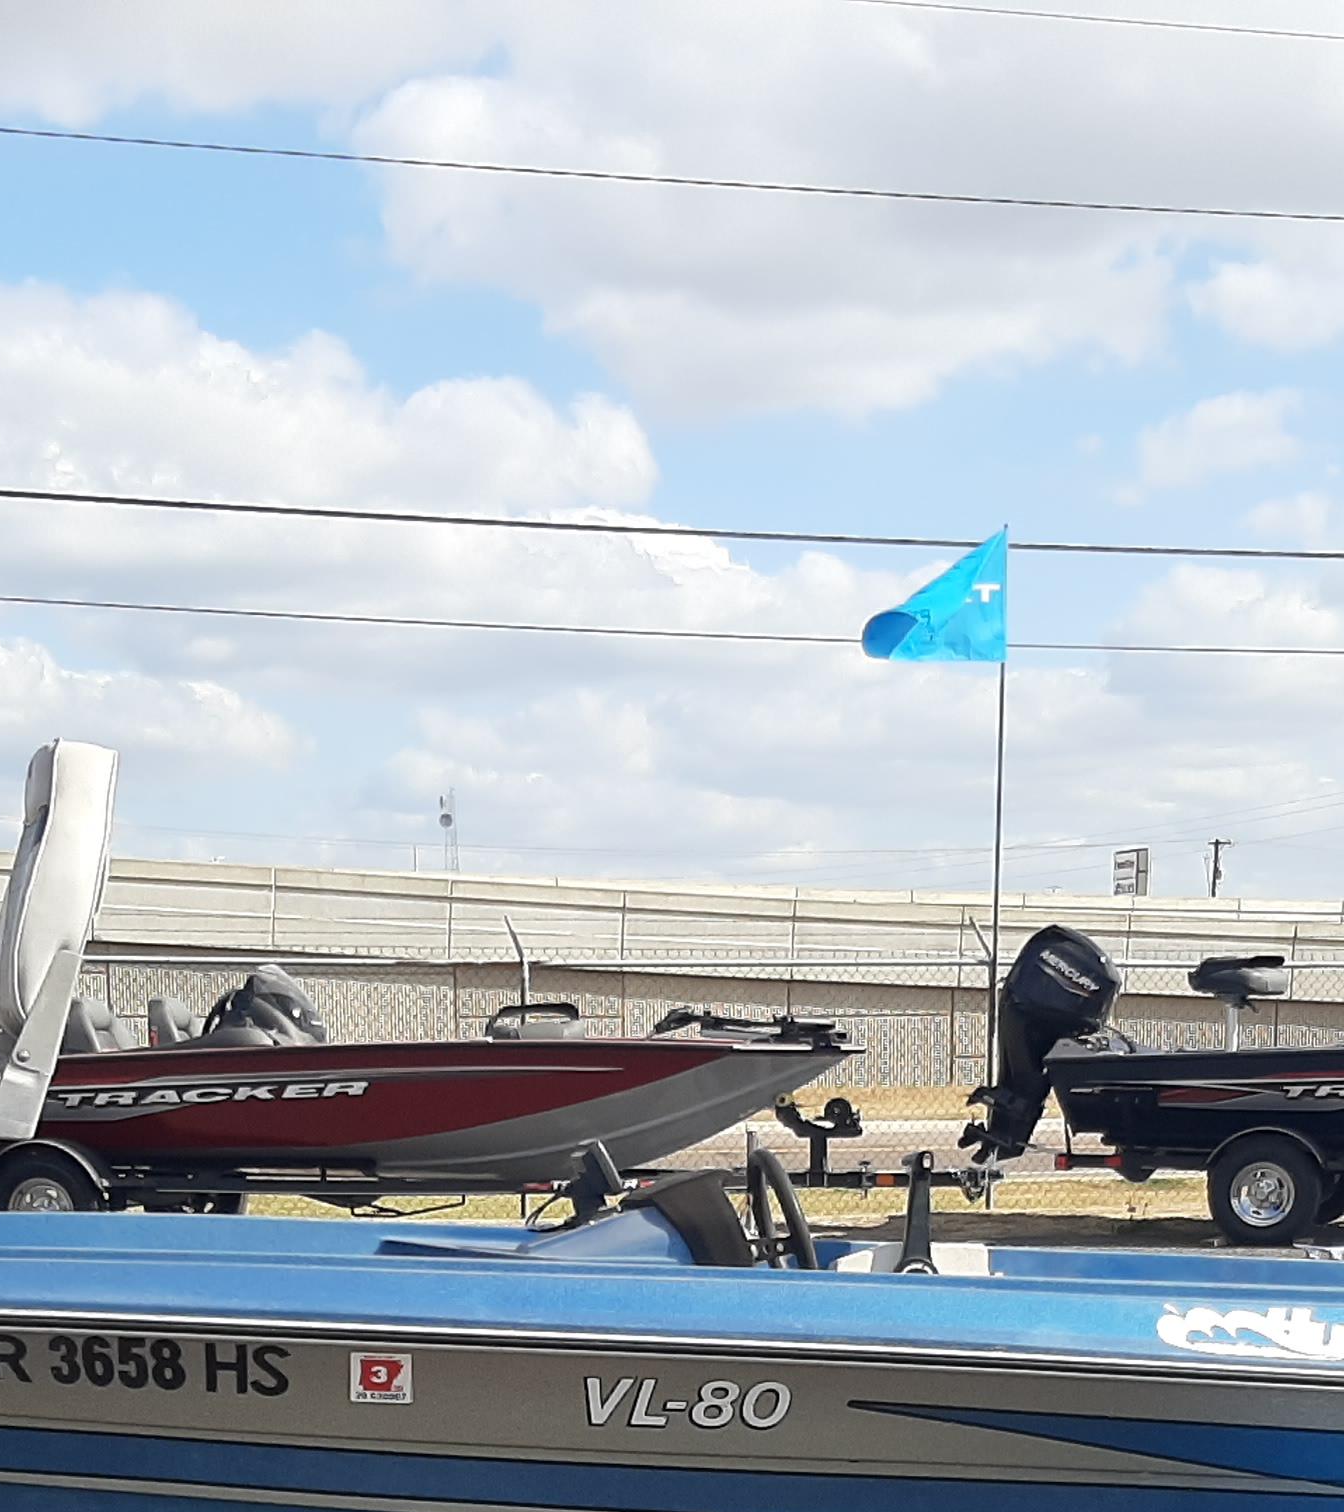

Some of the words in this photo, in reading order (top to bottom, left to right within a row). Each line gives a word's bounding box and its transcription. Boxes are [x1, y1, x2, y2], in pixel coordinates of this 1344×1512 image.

[57, 1081, 369, 1107] TRACKER
[49, 1335, 187, 1391] 3658
[206, 1342, 292, 1397] HS
[369, 1365, 388, 1384] 3
[584, 1376, 792, 1431] VL-80
